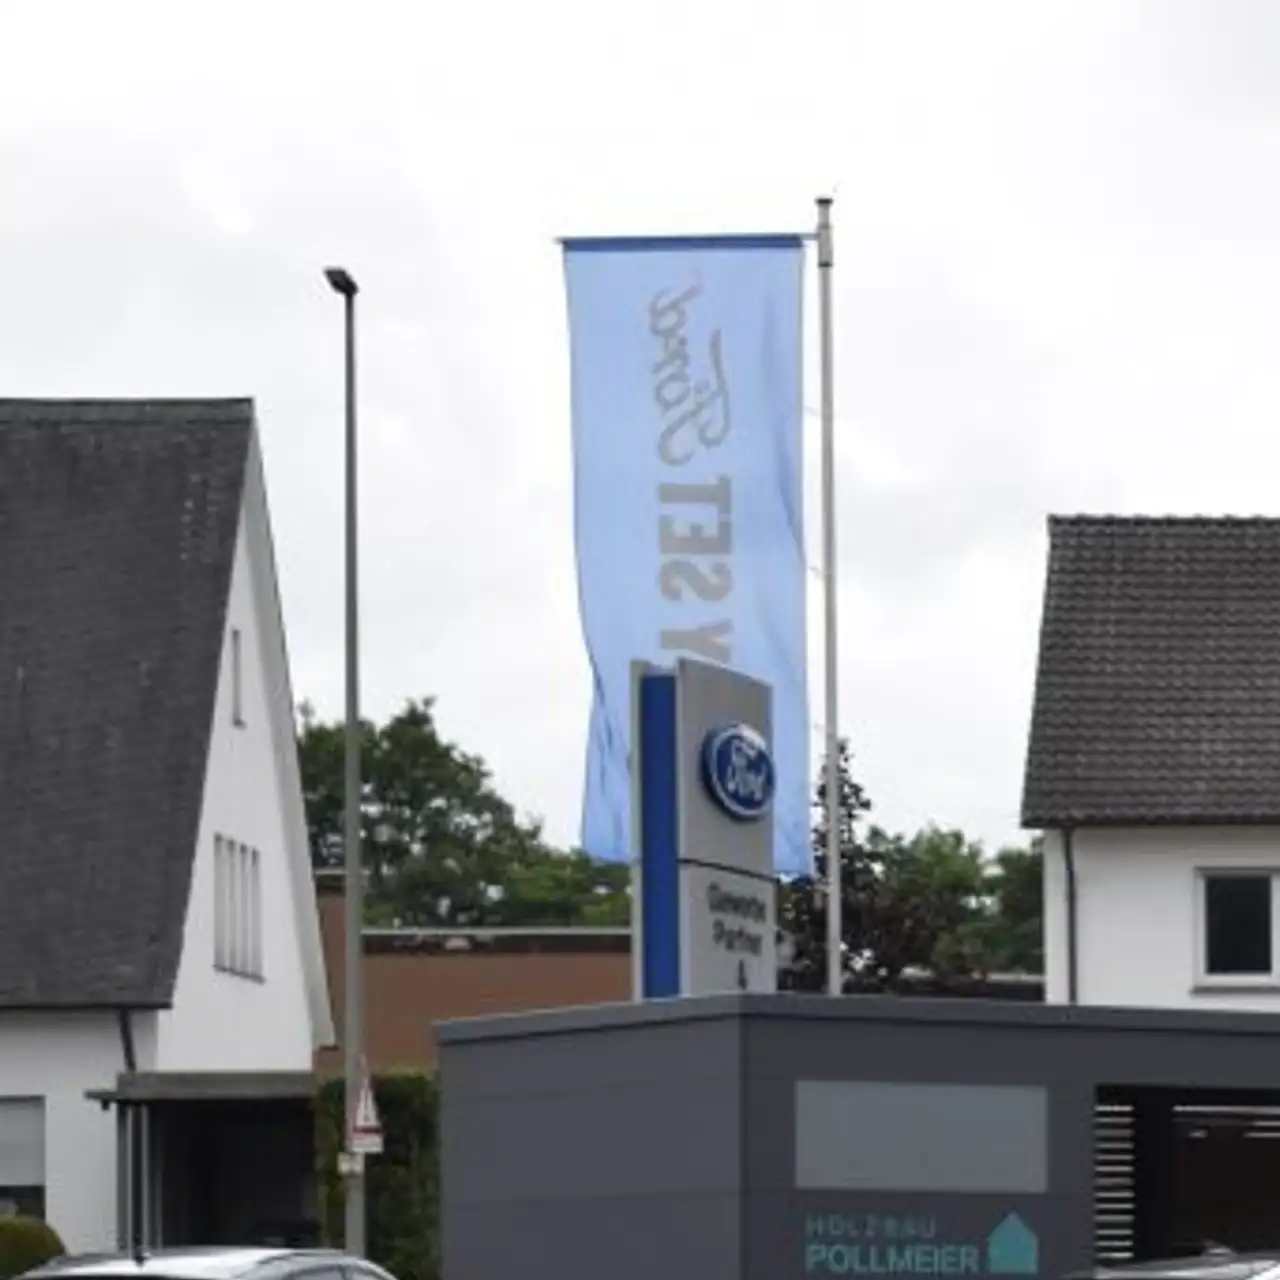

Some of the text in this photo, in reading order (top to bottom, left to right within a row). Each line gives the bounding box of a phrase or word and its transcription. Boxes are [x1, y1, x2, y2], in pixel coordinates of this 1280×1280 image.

[724, 738, 768, 802] Ford
[805, 1213, 936, 1237] HOLZBAU
[805, 1243, 979, 1273] POLLMEIER
